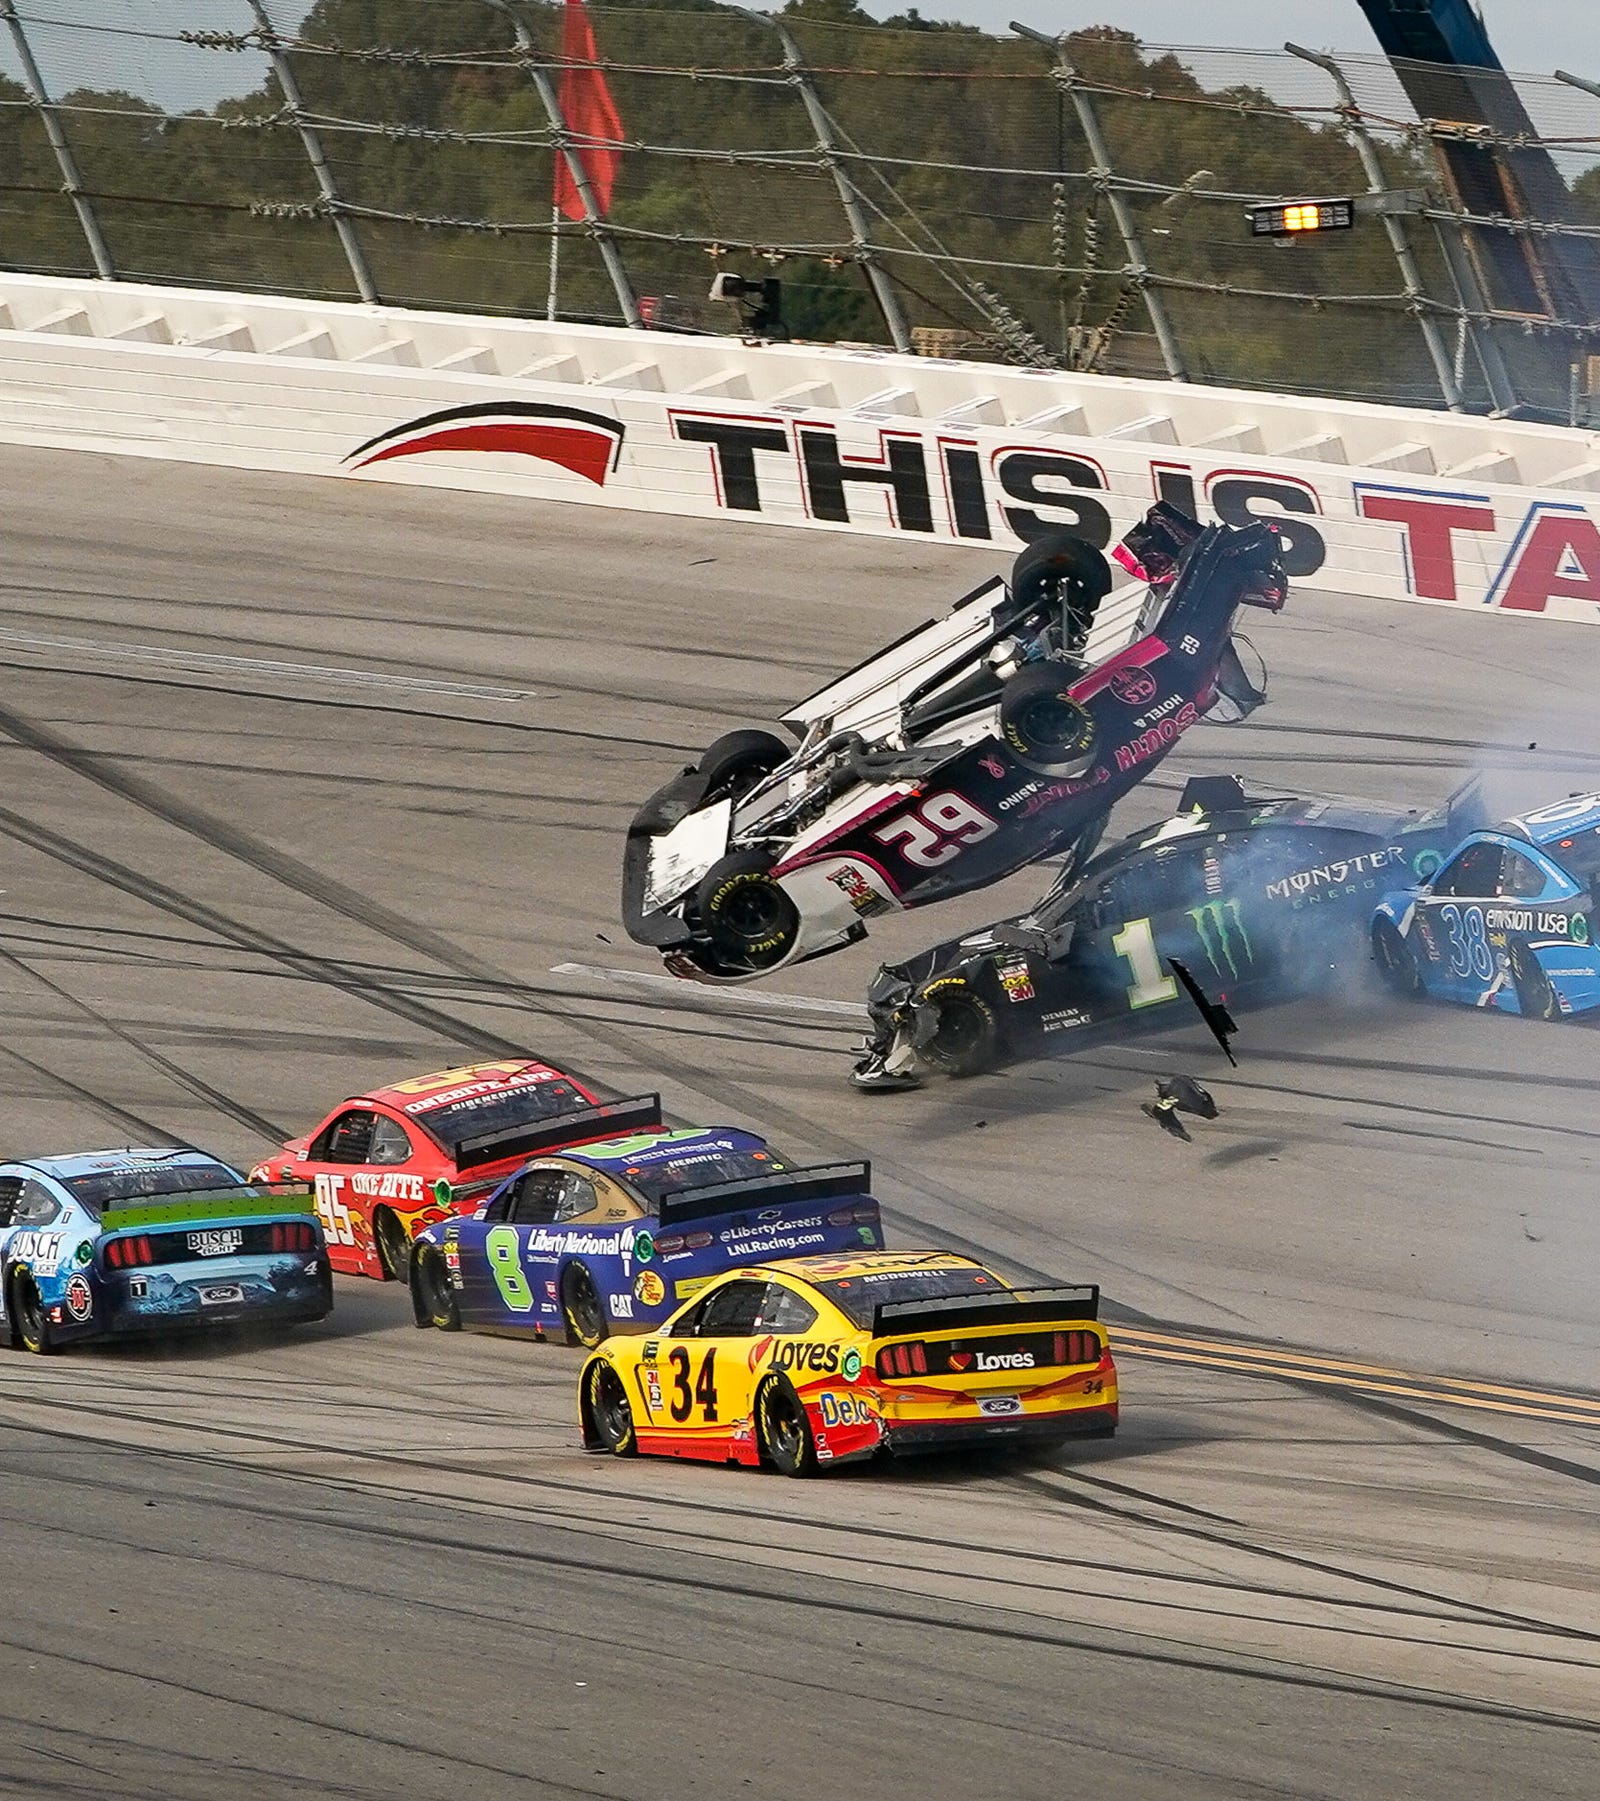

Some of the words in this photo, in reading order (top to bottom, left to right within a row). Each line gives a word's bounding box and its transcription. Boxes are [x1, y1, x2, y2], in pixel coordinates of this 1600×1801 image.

[667, 407, 1112, 550] THIS
[1180, 634, 1200, 655] 62
[1143, 693, 1184, 720] HOTEL
[1114, 701, 1201, 773] SOUTH
[998, 778, 1046, 811] CASINO
[870, 788, 1001, 868] 62
[1266, 845, 1408, 900] MONSTER
[1292, 878, 1377, 911] ENERG
[1440, 903, 1495, 982] 38
[1538, 912, 1568, 935] usa
[1112, 917, 1179, 1010] 1
[1011, 984, 1035, 1002] 3M
[668, 1153, 723, 1168] HEMRIC
[314, 1173, 355, 1245] 95
[351, 1172, 381, 1195] ONE
[380, 1173, 425, 1200] BITE
[187, 1229, 243, 1250] BUSCH
[719, 1215, 823, 1243] @LibertyCareers
[726, 1231, 825, 1257] LNLRacing.com
[303, 1260, 318, 1276] 4
[485, 1225, 534, 1313] 8
[527, 1228, 565, 1257] Liberty
[564, 1230, 620, 1256] National
[609, 1293, 634, 1318] CAT
[975, 1351, 1036, 1372] Loves
[668, 1345, 719, 1423] 34
[768, 1339, 841, 1373] Loves
[1082, 1380, 1104, 1396] 34
[989, 1401, 1013, 1411] Ford
